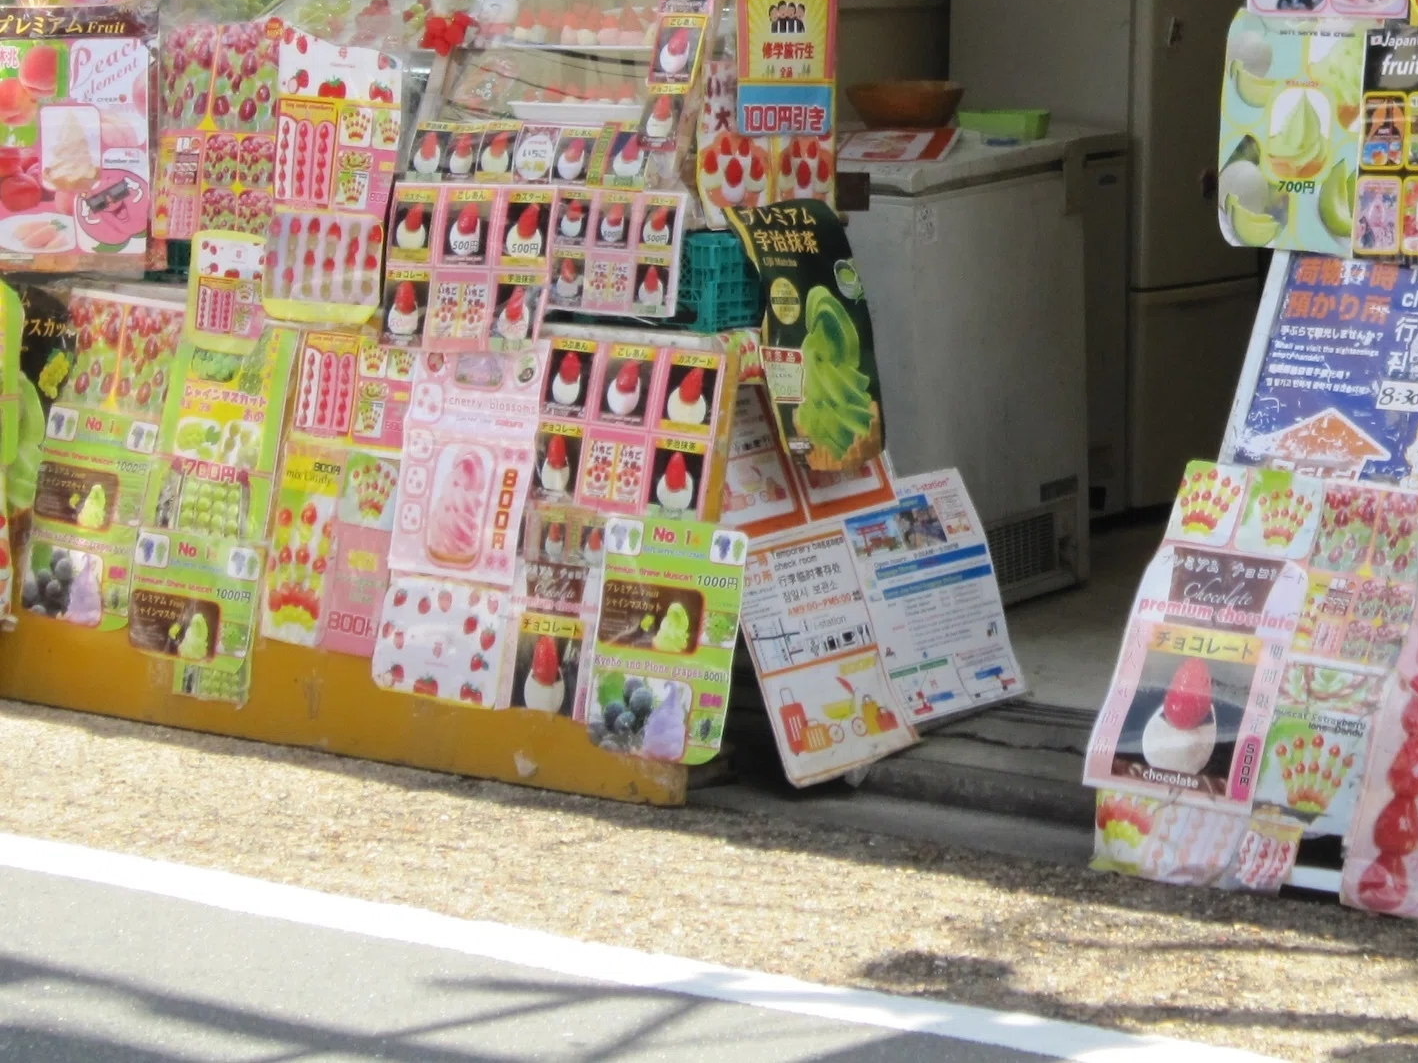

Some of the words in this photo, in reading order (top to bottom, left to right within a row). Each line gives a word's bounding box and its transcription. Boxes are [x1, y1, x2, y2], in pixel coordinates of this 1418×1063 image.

[0, 14, 84, 35] プレミアム
[86, 21, 127, 35] Fruit
[762, 41, 815, 60] 修学旅行生
[1381, 33, 1417, 50] Japan
[71, 37, 141, 90] Peach
[83, 57, 139, 101] element
[743, 104, 826, 133] 100円引き
[457, 192, 486, 201] こしあん
[513, 191, 548, 201] カスタード
[1277, 180, 1316, 195] 700円
[738, 206, 817, 227] プレミアム
[452, 240, 479, 252] 500円
[510, 242, 540, 255] 500円
[753, 228, 820, 254] 宇治抹茶
[387, 269, 429, 279] チョコレート
[1283, 290, 1392, 325] 預かり所
[561, 340, 589, 352] つぶあん
[616, 348, 649, 360] こしあん
[676, 354, 714, 366] カスタード
[448, 396, 484, 412] cherry
[488, 400, 538, 415] blossoms
[540, 422, 582, 435] チョコレート
[665, 438, 697, 451] 宇治抹茶
[182, 459, 239, 484] 700円
[653, 525, 678, 544] No.
[770, 544, 811, 560] Temporary
[774, 560, 797, 572] check
[798, 554, 818, 565] room
[696, 573, 739, 590] 1000円
[215, 587, 251, 603] 1000円
[1182, 577, 1254, 606] Chocolate
[1138, 596, 1213, 620] premium
[1216, 605, 1296, 630] chocolate
[522, 618, 583, 637] チョコレート
[1155, 631, 1254, 660] チョコレート
[1142, 769, 1200, 790] chocolate
